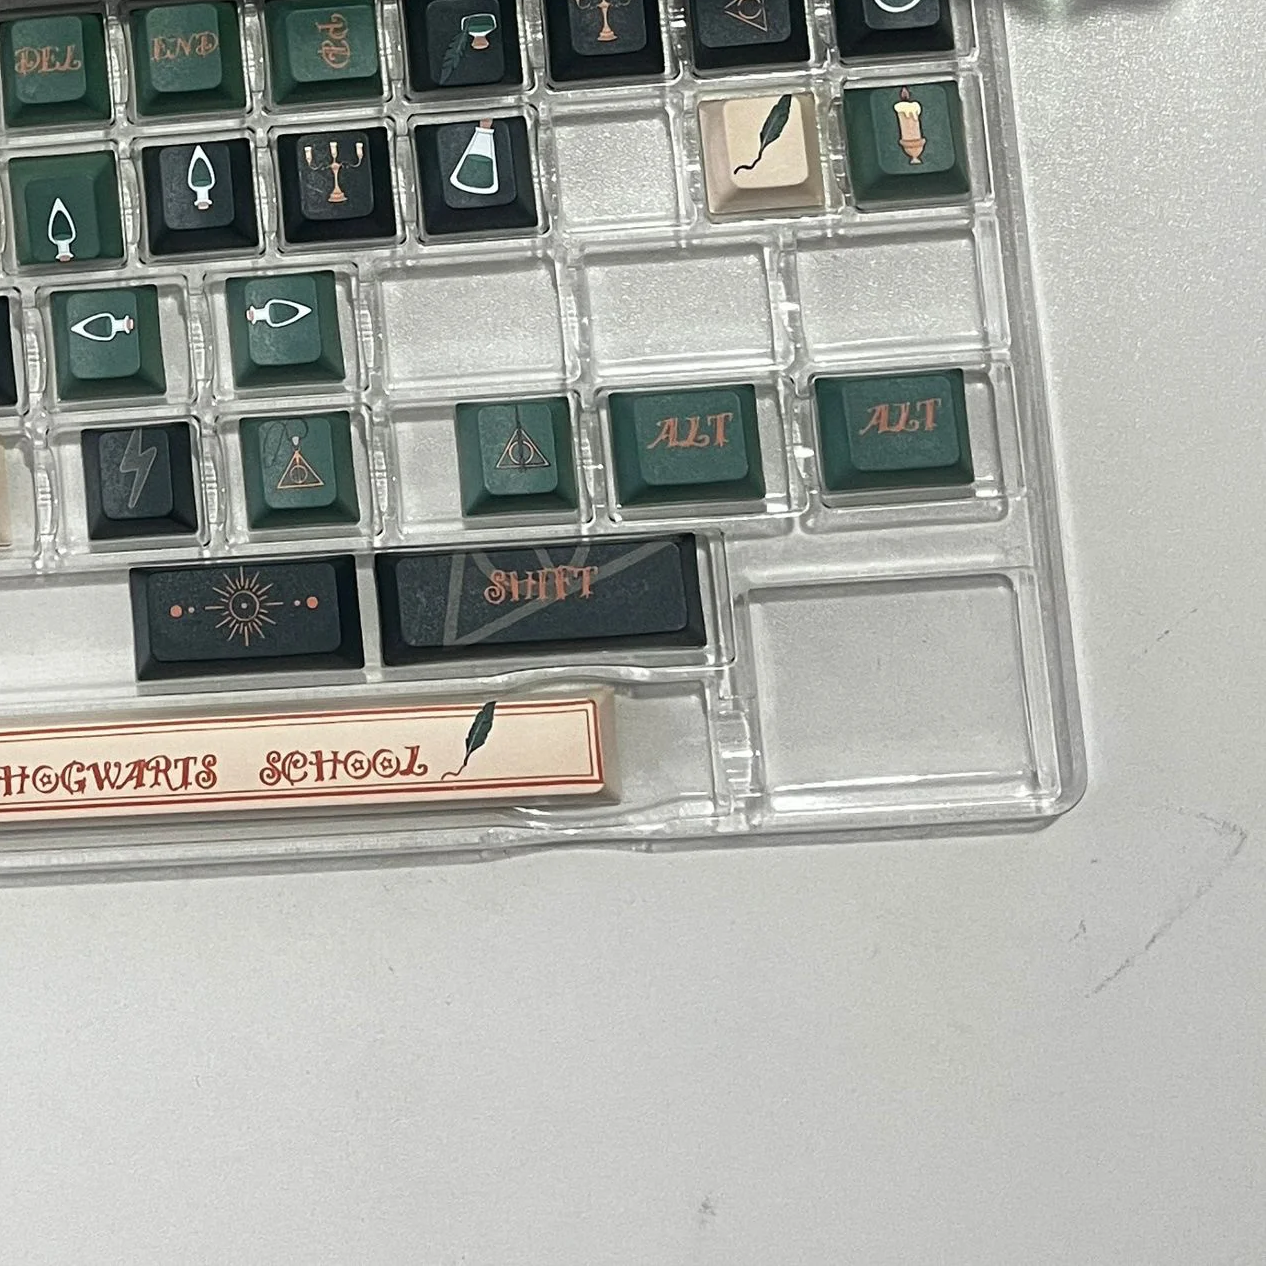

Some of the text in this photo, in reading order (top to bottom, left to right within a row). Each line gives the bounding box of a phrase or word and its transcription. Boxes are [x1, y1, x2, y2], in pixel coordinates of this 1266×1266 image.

[14, 44, 82, 77] DEL
[150, 30, 219, 63] END
[646, 411, 734, 450] ALT
[860, 397, 943, 436] ALT
[483, 564, 600, 605] SHIFT
[258, 744, 429, 787] SCHOOL
